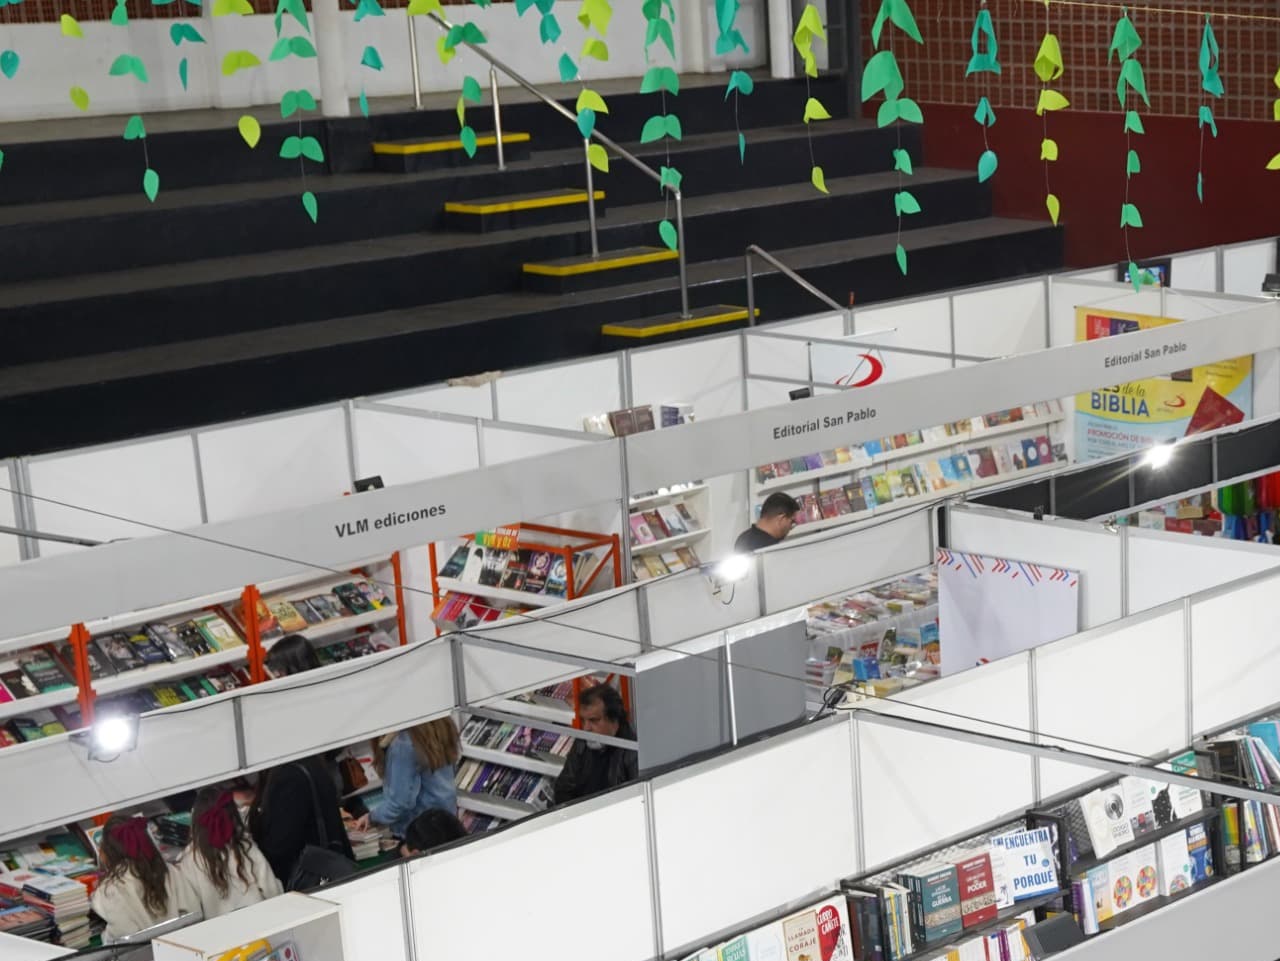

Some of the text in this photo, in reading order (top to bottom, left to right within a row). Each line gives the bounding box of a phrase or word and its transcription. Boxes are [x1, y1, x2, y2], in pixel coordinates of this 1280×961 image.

[1104, 342, 1187, 368] Editorial San Pablo
[1091, 392, 1150, 417] BIBLIA
[772, 406, 877, 440] Editorial San Pablo
[334, 504, 447, 539] VLM ediciones
[1004, 828, 1049, 850] ENCUENTRA
[1023, 853, 1037, 867] TU
[967, 880, 987, 893] PODER
[788, 927, 816, 943] LLAMADA
[789, 938, 817, 953] CORAJE
